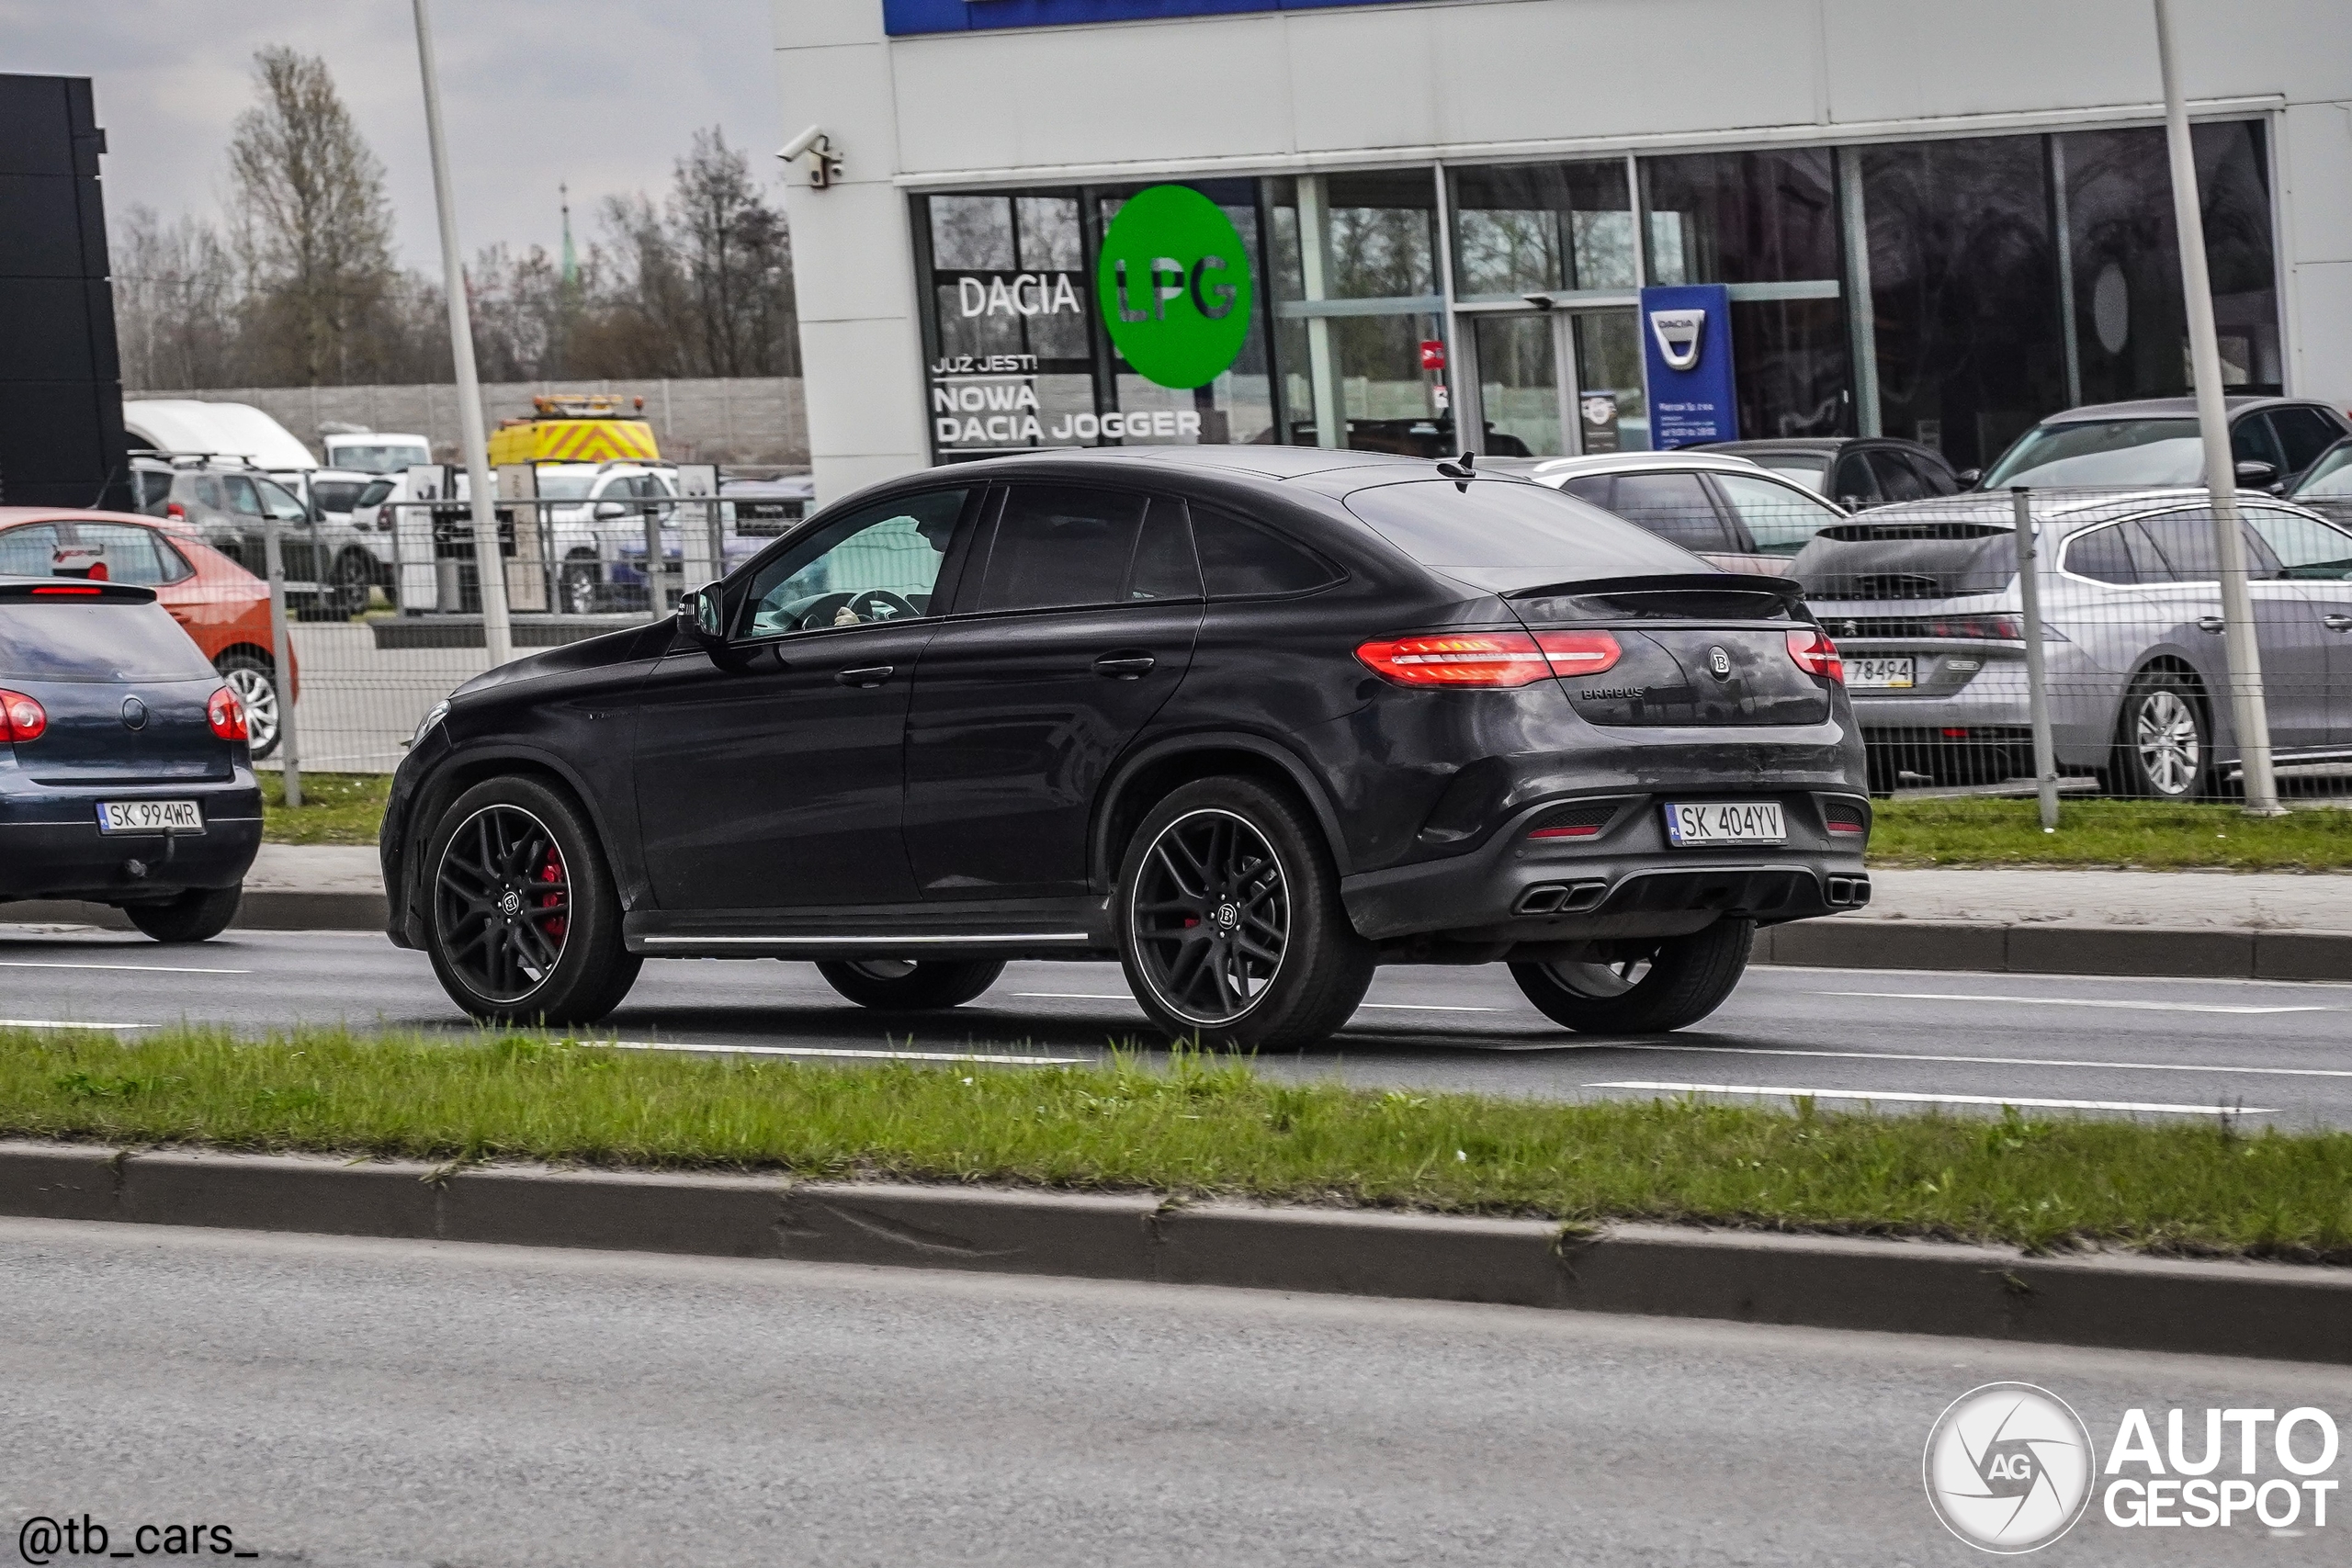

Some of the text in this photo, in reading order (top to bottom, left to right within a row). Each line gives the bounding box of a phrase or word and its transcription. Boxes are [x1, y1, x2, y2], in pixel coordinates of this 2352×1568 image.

[958, 274, 1080, 318] DACIA
[1114, 255, 1237, 322] LPG
[932, 354, 1038, 374] JUŻ JEST!
[933, 385, 1040, 412] NOWA
[937, 411, 1202, 442] DACIA JOGGER
[1853, 660, 1909, 681] 78494
[1582, 688, 1645, 700] BRABUS
[110, 804, 197, 827] SK 994WR
[1681, 806, 1778, 837] SK 404YV
